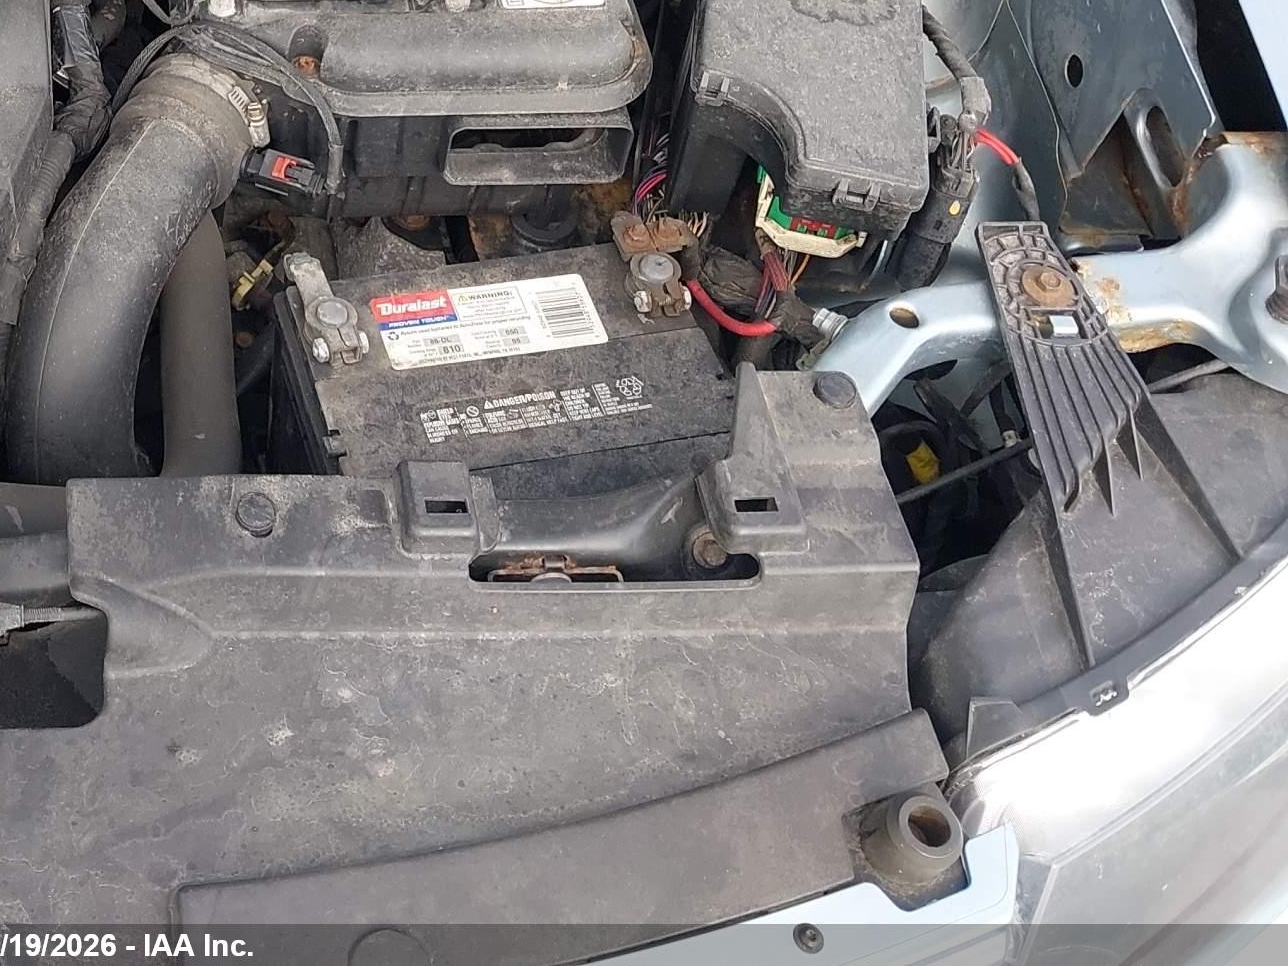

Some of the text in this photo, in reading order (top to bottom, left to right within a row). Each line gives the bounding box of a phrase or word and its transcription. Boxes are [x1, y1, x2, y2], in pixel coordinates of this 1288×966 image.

[376, 296, 447, 316] Duralast
[388, 318, 420, 328] PROVEN
[492, 390, 556, 408] DANGER/POISON
